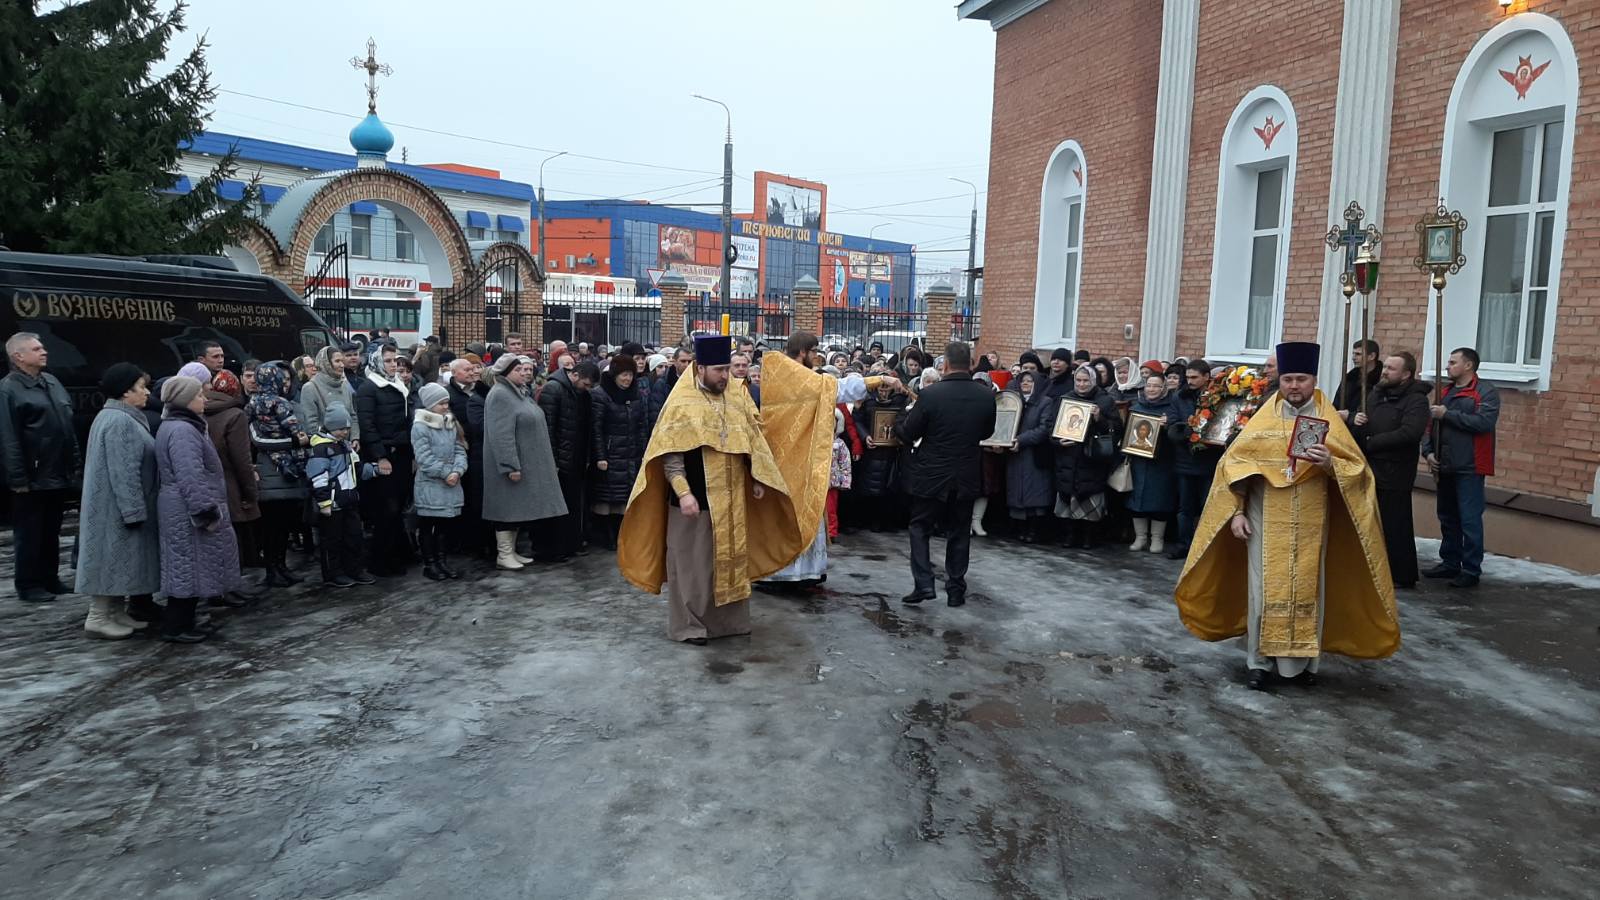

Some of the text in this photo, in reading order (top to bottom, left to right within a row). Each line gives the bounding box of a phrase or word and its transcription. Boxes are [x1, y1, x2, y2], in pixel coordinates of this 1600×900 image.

[358, 276, 412, 288] МАГНИТ
[47, 293, 176, 322] ВОЗНЕСЕНИЕ
[197, 302, 288, 316] РИТУАЛЬНАЯ СЛУЖБА
[241, 315, 280, 328] 73-93-93
